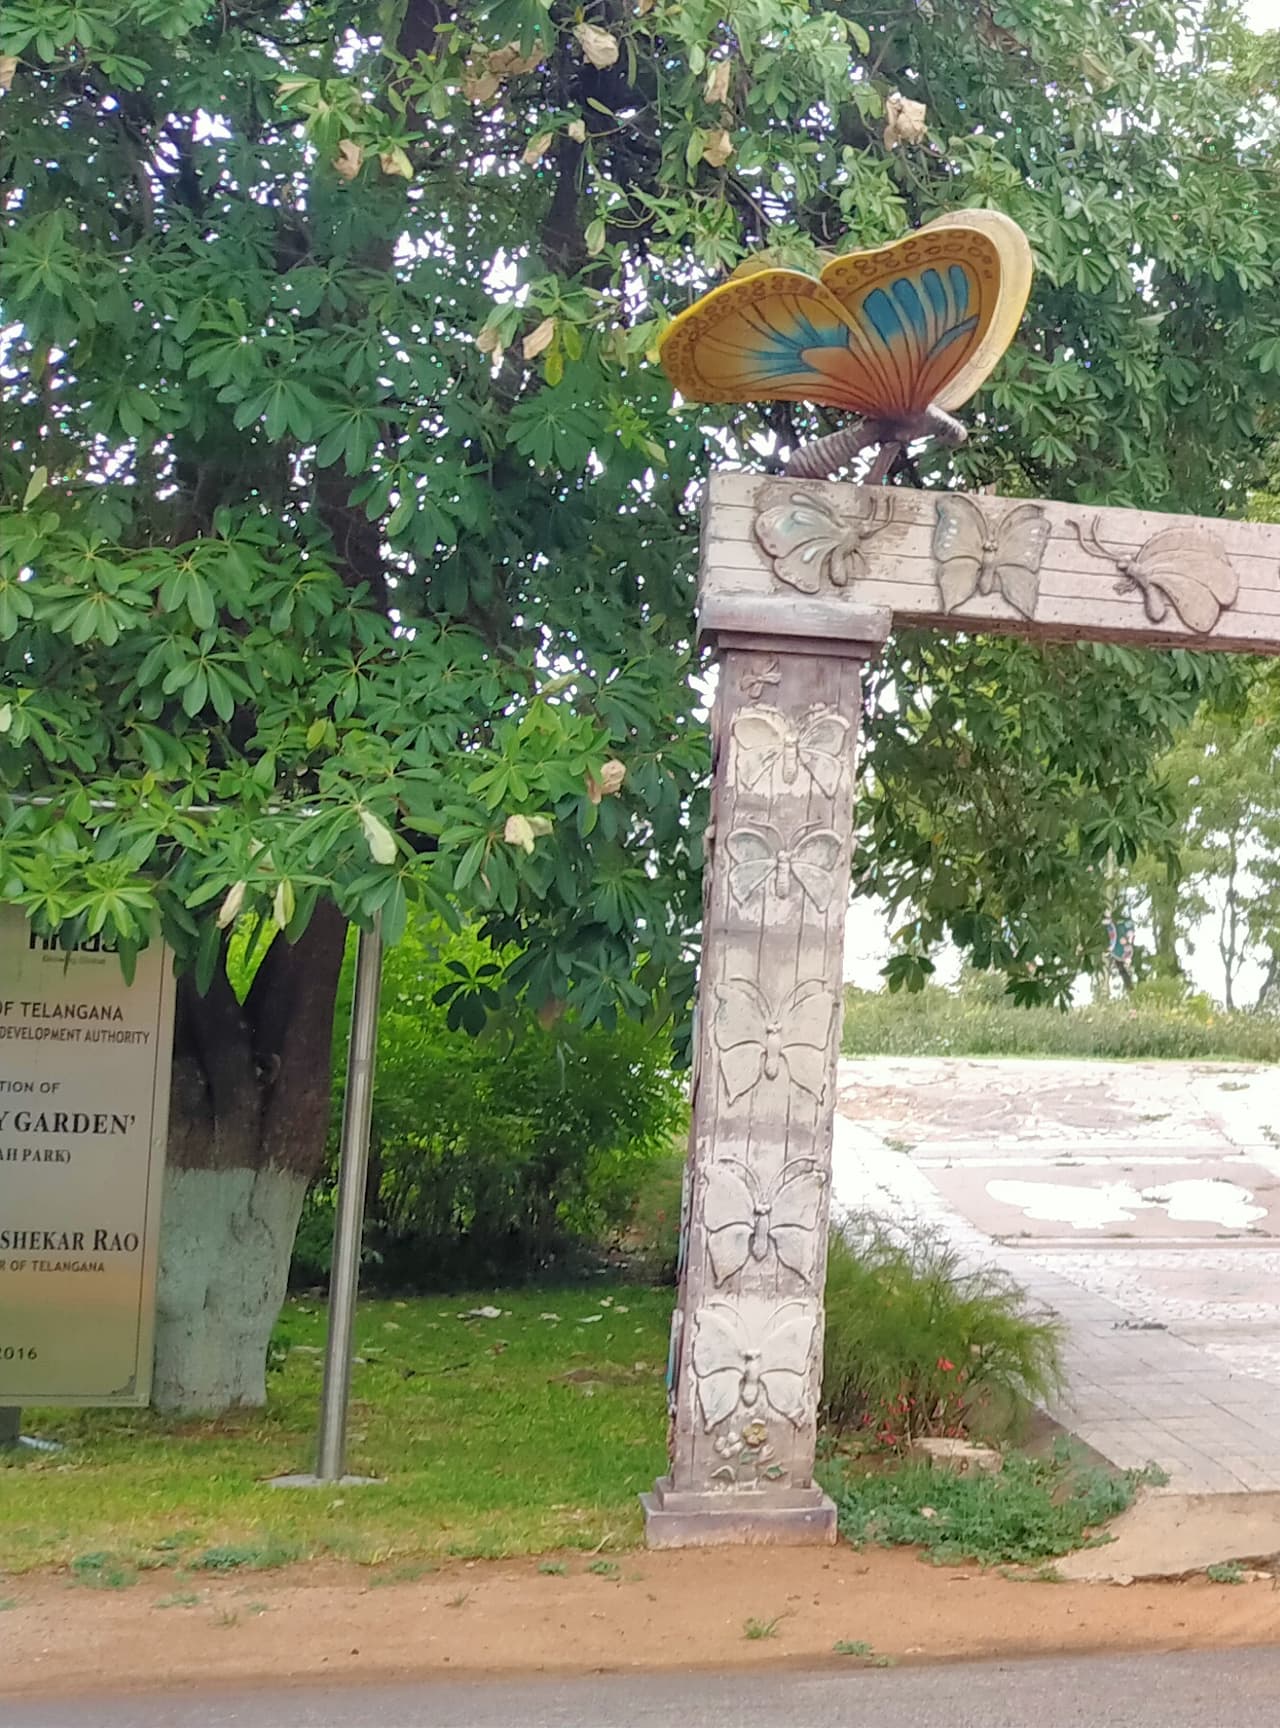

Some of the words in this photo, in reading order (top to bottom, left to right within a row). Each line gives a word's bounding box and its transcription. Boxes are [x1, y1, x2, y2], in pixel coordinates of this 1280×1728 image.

[21, 1002, 124, 1021] TELANGANA
[0, 1026, 82, 1042] DEVELOPMENT
[84, 1029, 151, 1044] AUTHORITY
[40, 1082, 61, 1093] OF
[22, 1149, 71, 1164] PARK)
[0, 1230, 84, 1251] SHEKAR
[10, 1260, 27, 1272] OF
[32, 1260, 105, 1272] TELANGANA
